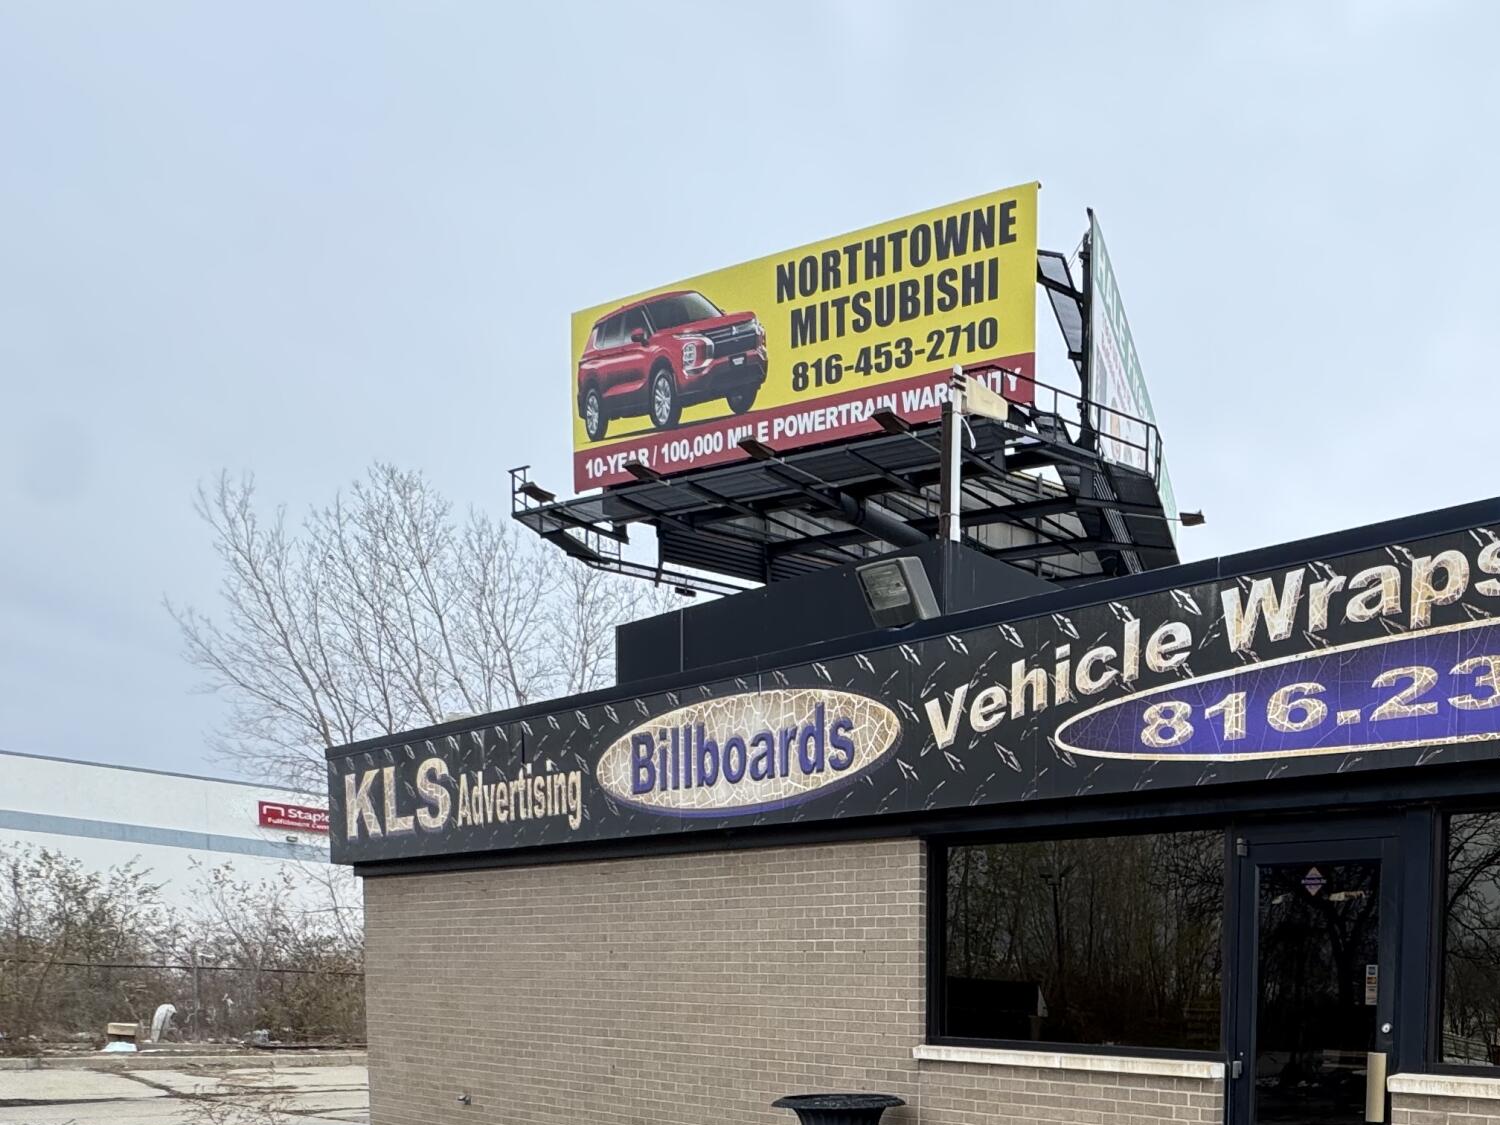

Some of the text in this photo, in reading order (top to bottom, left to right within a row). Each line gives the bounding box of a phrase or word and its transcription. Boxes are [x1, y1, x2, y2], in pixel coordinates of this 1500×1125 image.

[776, 199, 1017, 304] NORTHTOWNE
[790, 257, 999, 349] MITSUBISHI
[791, 317, 998, 392] 816-453-2710
[660, 431, 724, 464] 100,000
[901, 367, 1022, 414] WARNTY
[924, 618, 1194, 751] Vehicle
[630, 701, 856, 796] Billboards
[344, 757, 582, 840] KLS Advertising
